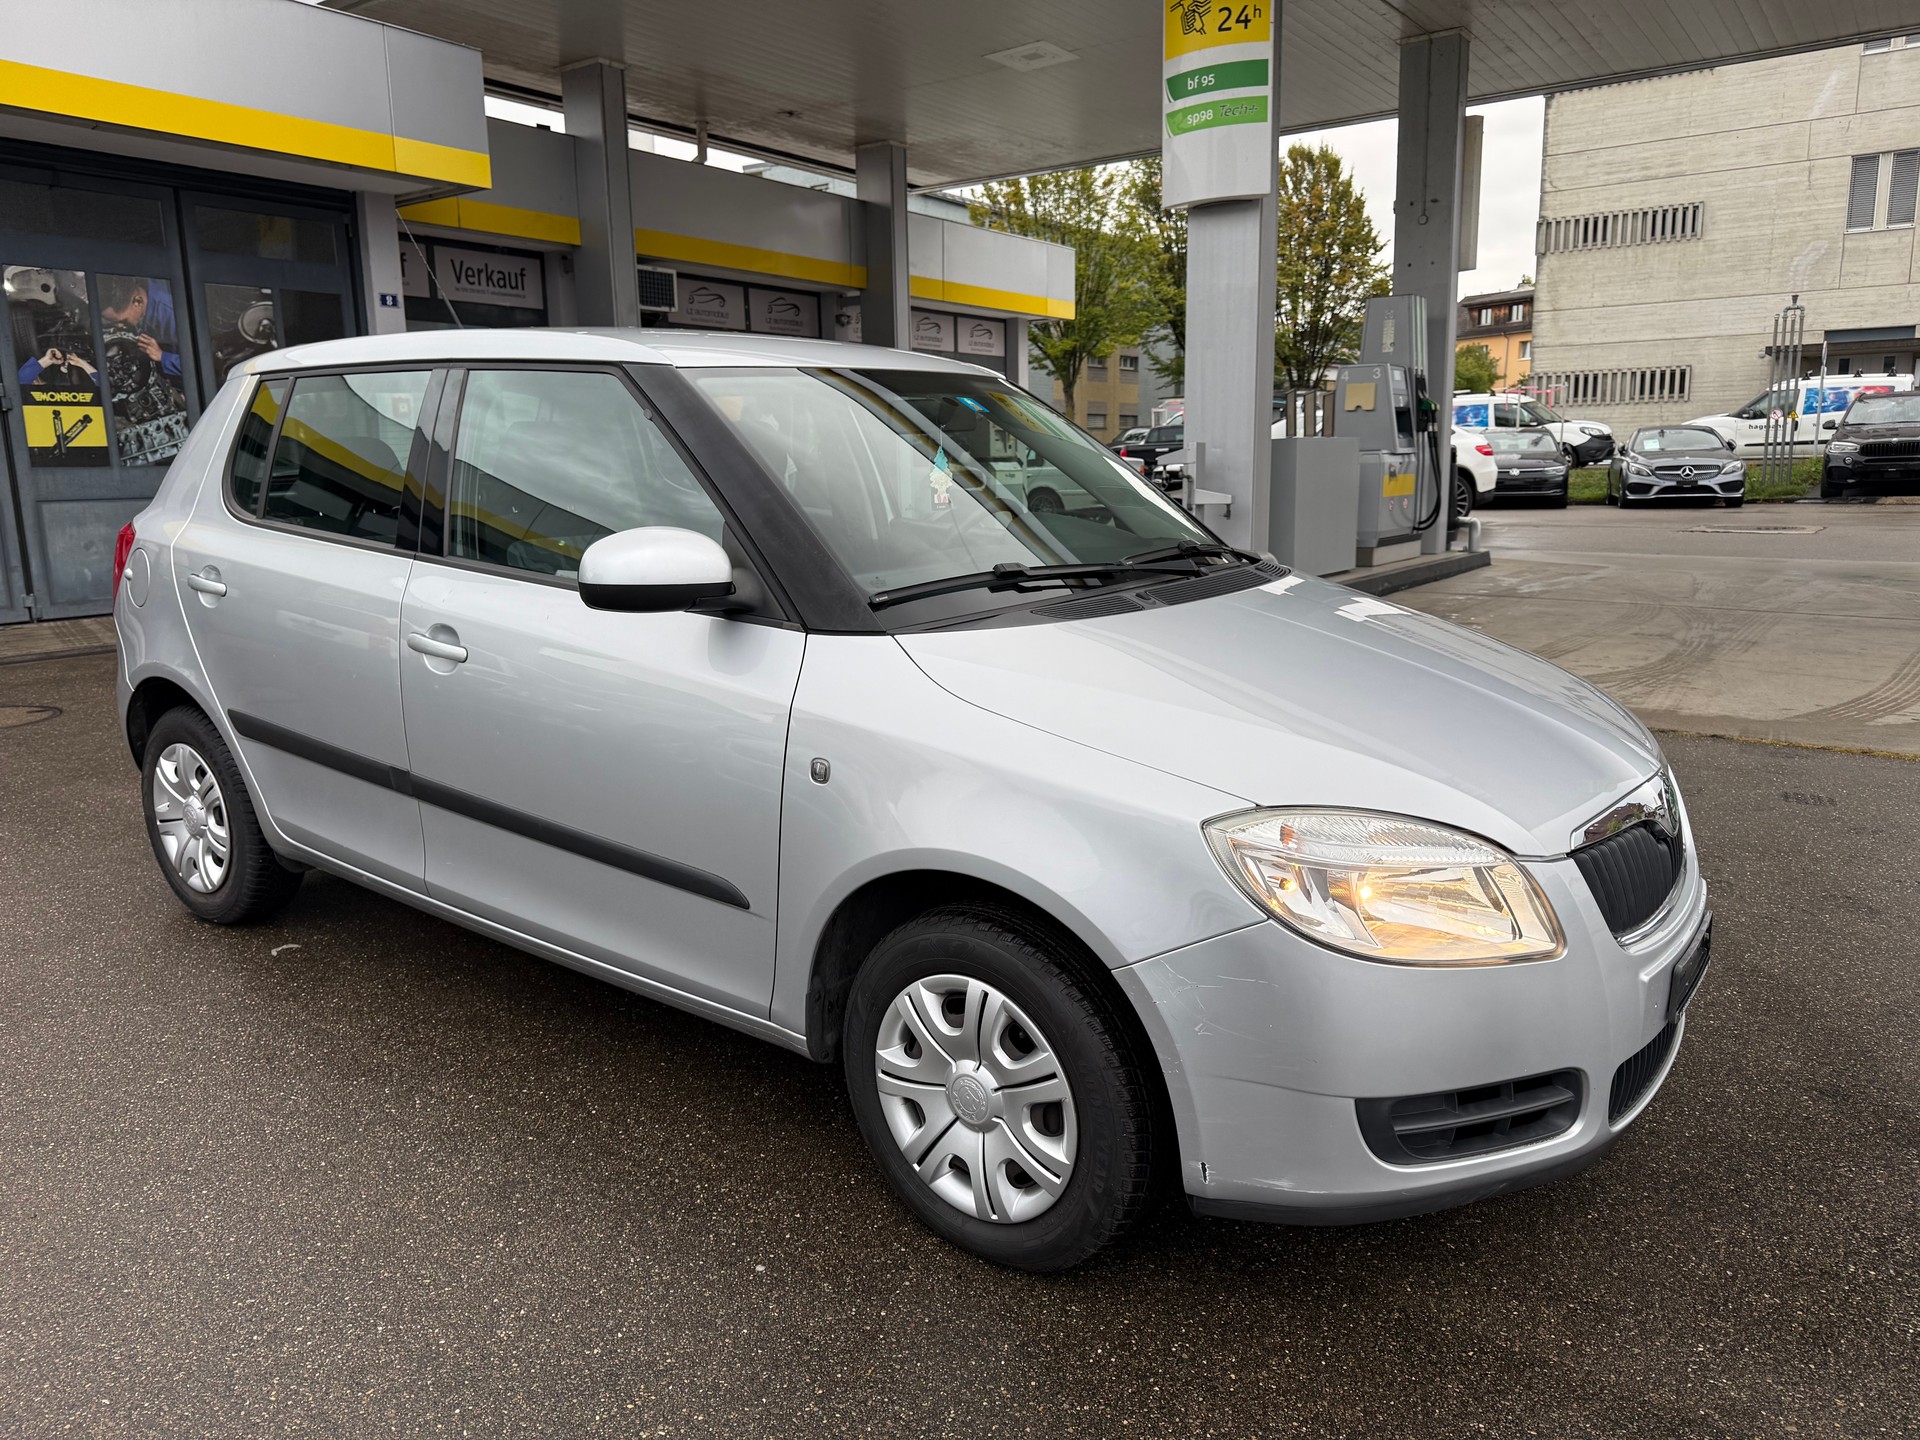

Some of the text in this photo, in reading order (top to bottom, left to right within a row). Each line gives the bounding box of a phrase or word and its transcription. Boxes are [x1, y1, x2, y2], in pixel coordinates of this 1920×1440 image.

[1217, 4, 1262, 32] 24h
[1187, 74, 1215, 90] bf 95
[1187, 103, 1258, 126] sp98 Tech+
[450, 258, 527, 292] Verkauf
[386, 295, 393, 306] 8
[1341, 371, 1349, 382] 4
[1372, 367, 1382, 379] 3
[38, 391, 90, 403] MONROE
